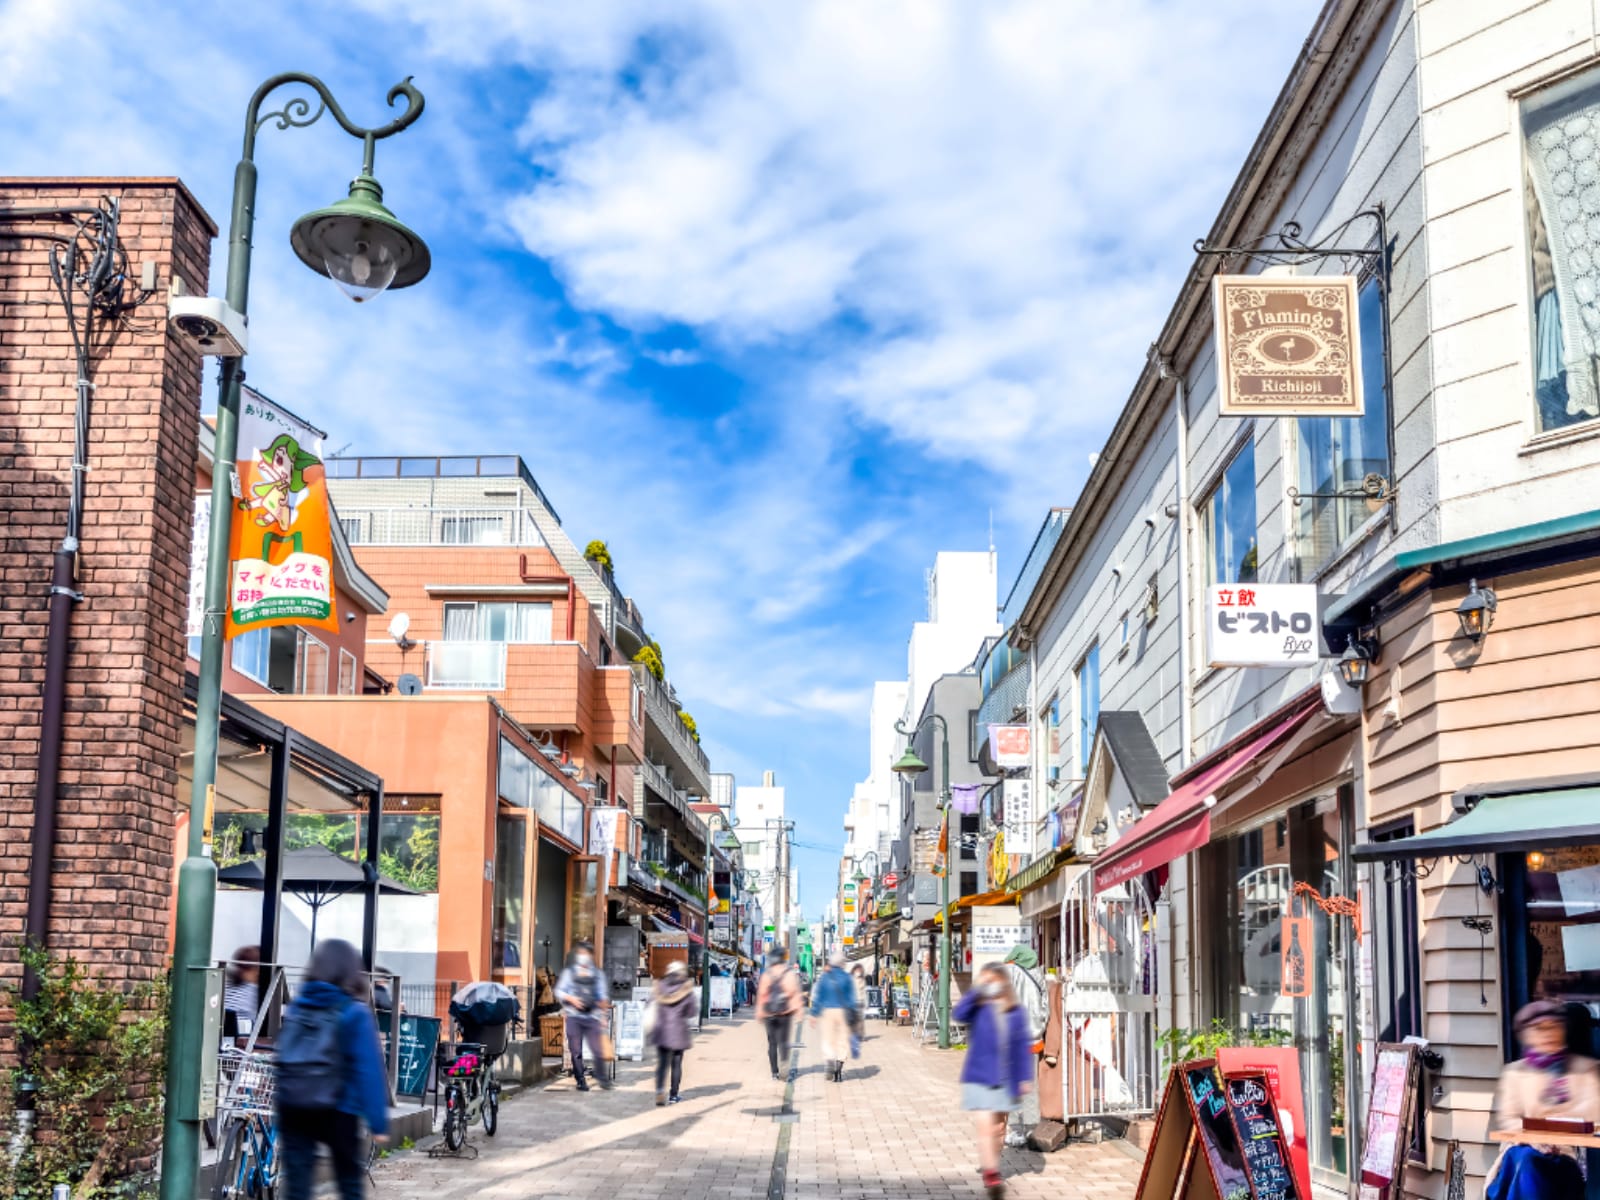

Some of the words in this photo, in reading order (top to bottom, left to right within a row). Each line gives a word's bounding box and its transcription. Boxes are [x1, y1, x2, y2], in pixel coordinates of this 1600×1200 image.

[1242, 308, 1334, 329] Flamingo
[1262, 379, 1322, 393] Kichijoji
[1217, 588, 1256, 607] 立飲
[1218, 610, 1312, 634] ビストロ
[1283, 635, 1313, 659] Ryo
